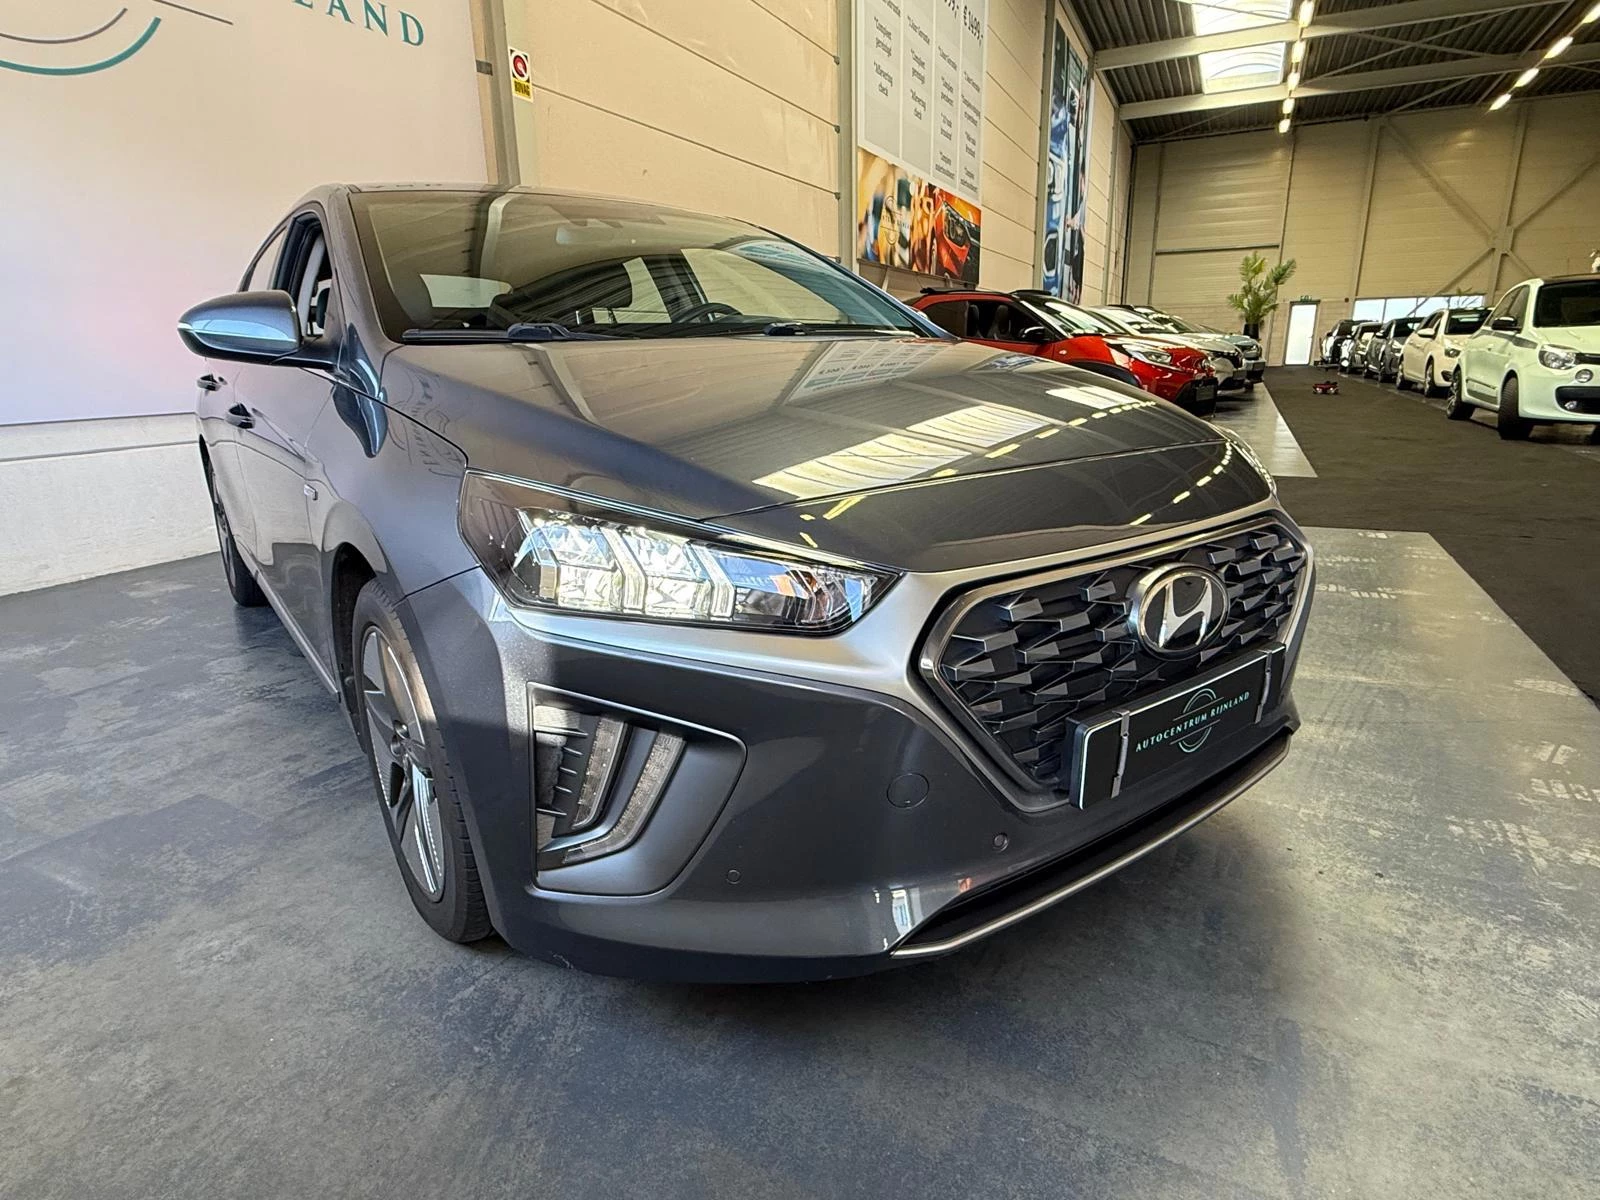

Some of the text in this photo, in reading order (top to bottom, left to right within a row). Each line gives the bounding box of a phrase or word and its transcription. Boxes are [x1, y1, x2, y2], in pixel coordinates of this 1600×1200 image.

[293, 0, 424, 47] AND
[1135, 691, 1250, 752] AUTOCENTRUM RIJNLAND
